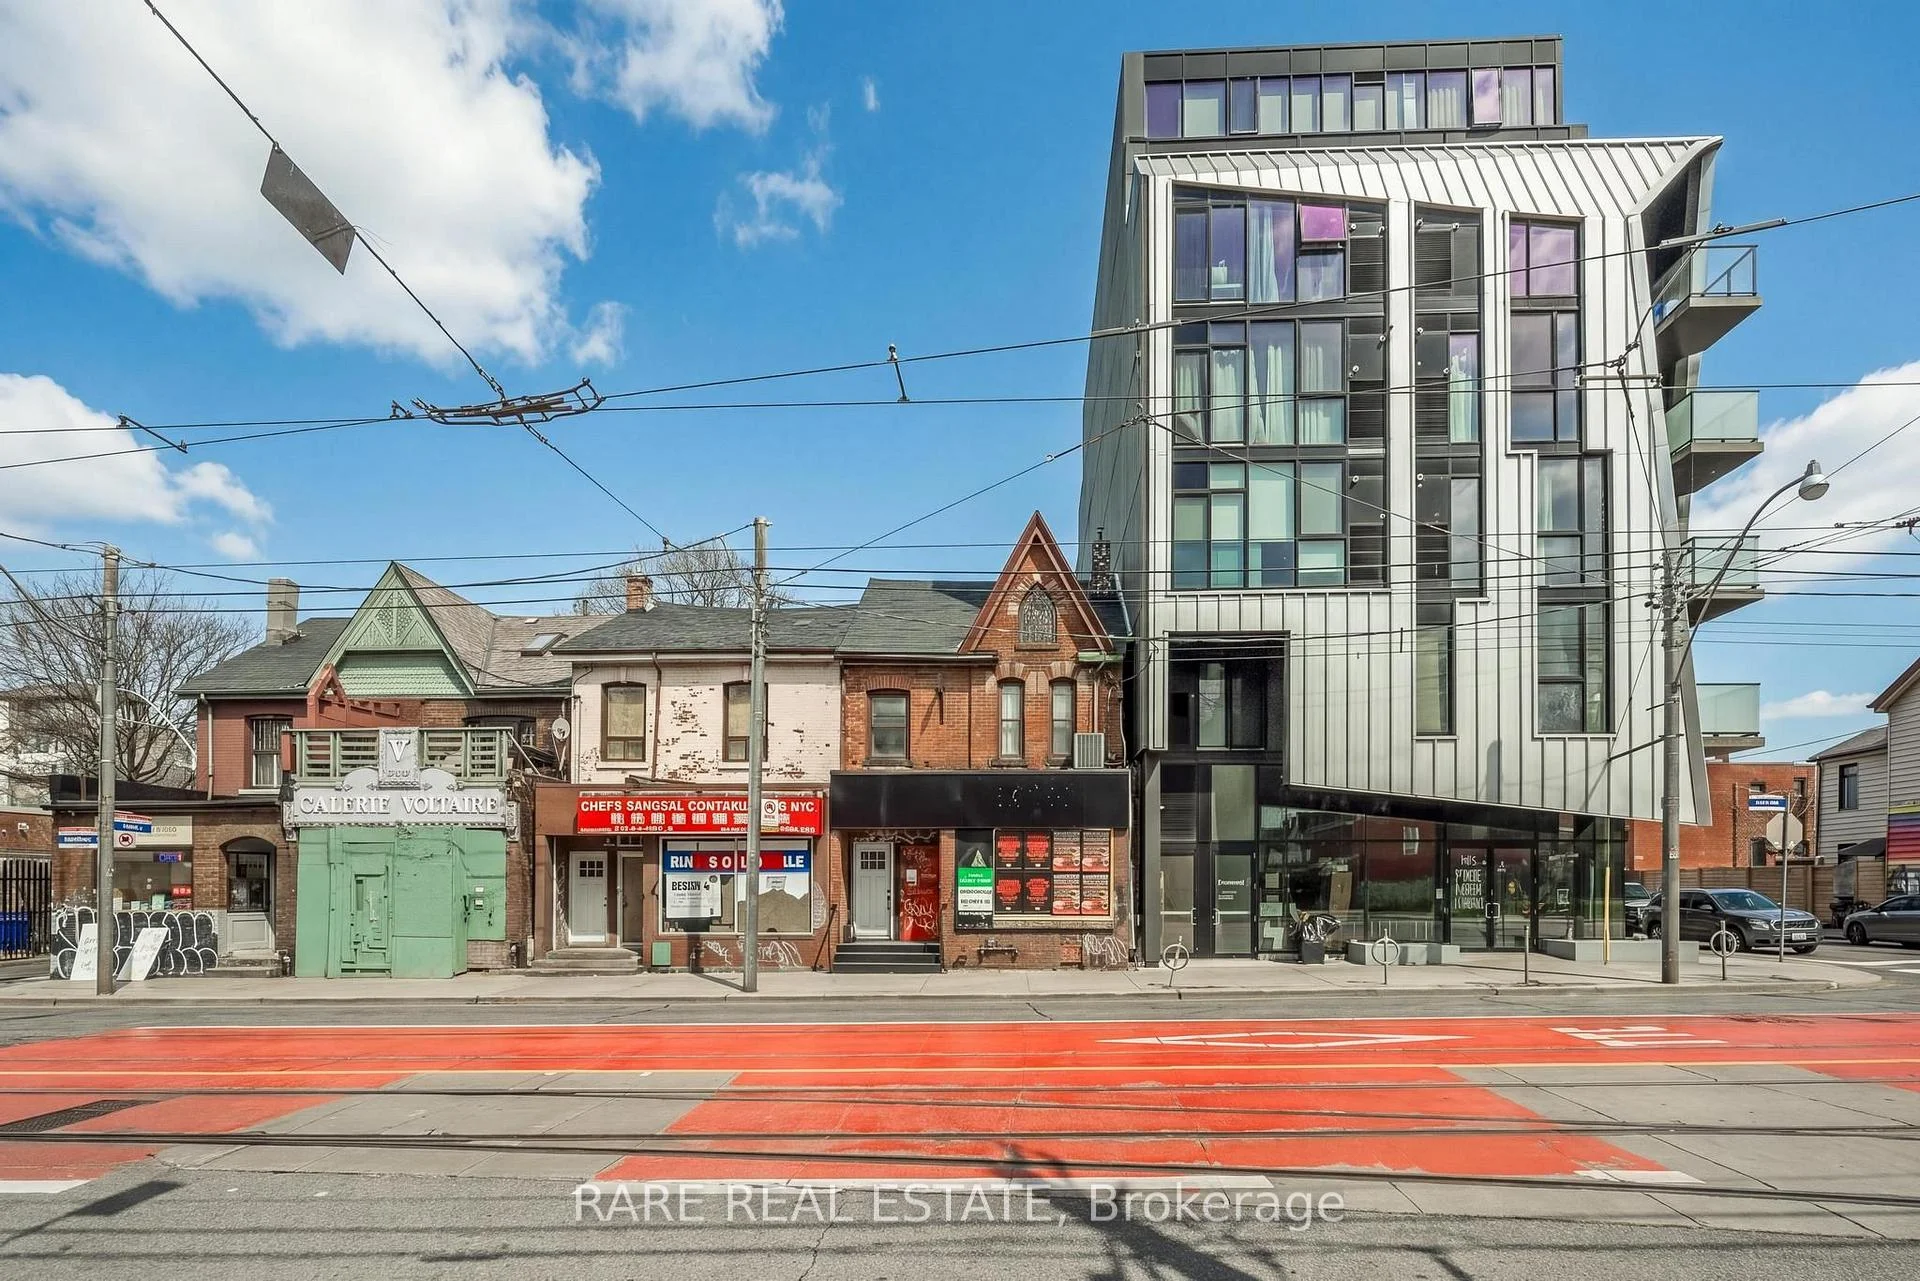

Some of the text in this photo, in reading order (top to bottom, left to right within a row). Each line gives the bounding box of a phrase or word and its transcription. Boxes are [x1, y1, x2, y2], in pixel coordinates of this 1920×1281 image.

[388, 739, 410, 762] V
[401, 796, 498, 814] VOLTAIRE
[581, 801, 622, 811] CHEFS
